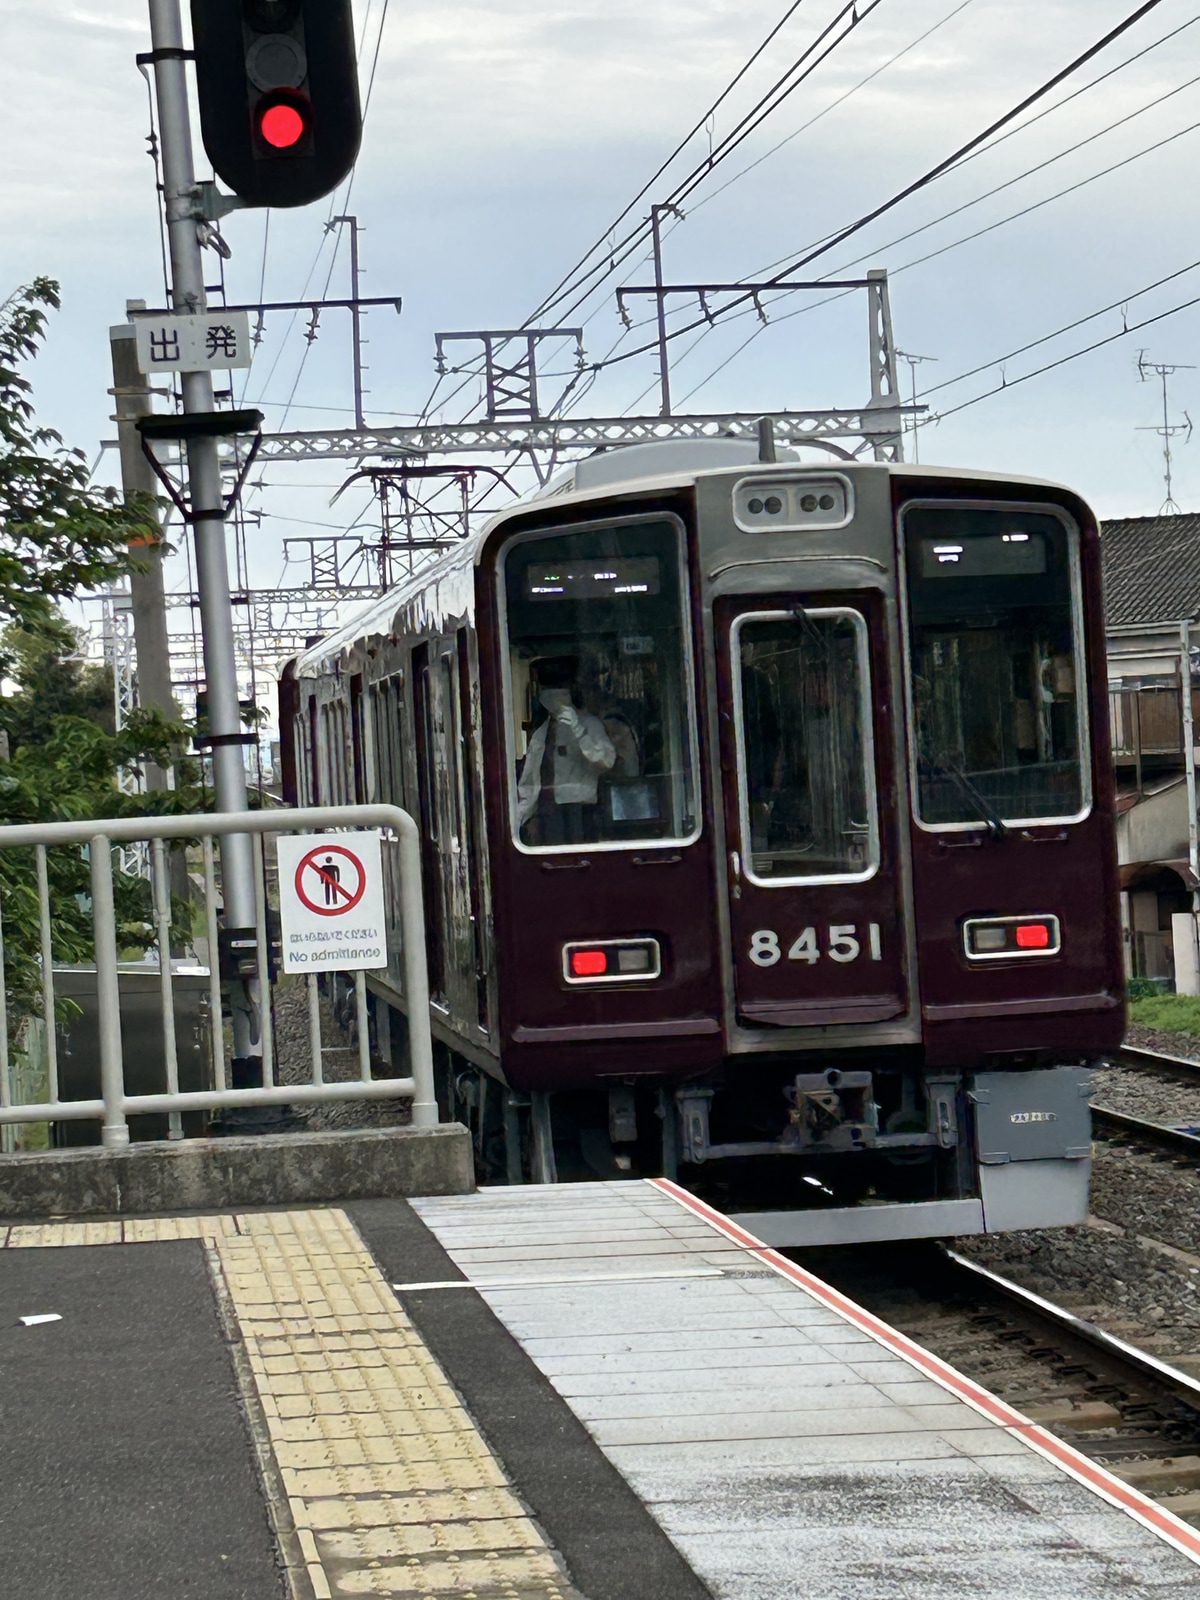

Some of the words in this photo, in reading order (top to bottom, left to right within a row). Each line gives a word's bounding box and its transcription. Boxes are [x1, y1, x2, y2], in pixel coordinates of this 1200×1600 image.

[150, 325, 237, 362] 出発
[290, 952, 308, 962] No
[749, 923, 882, 967] 8451
